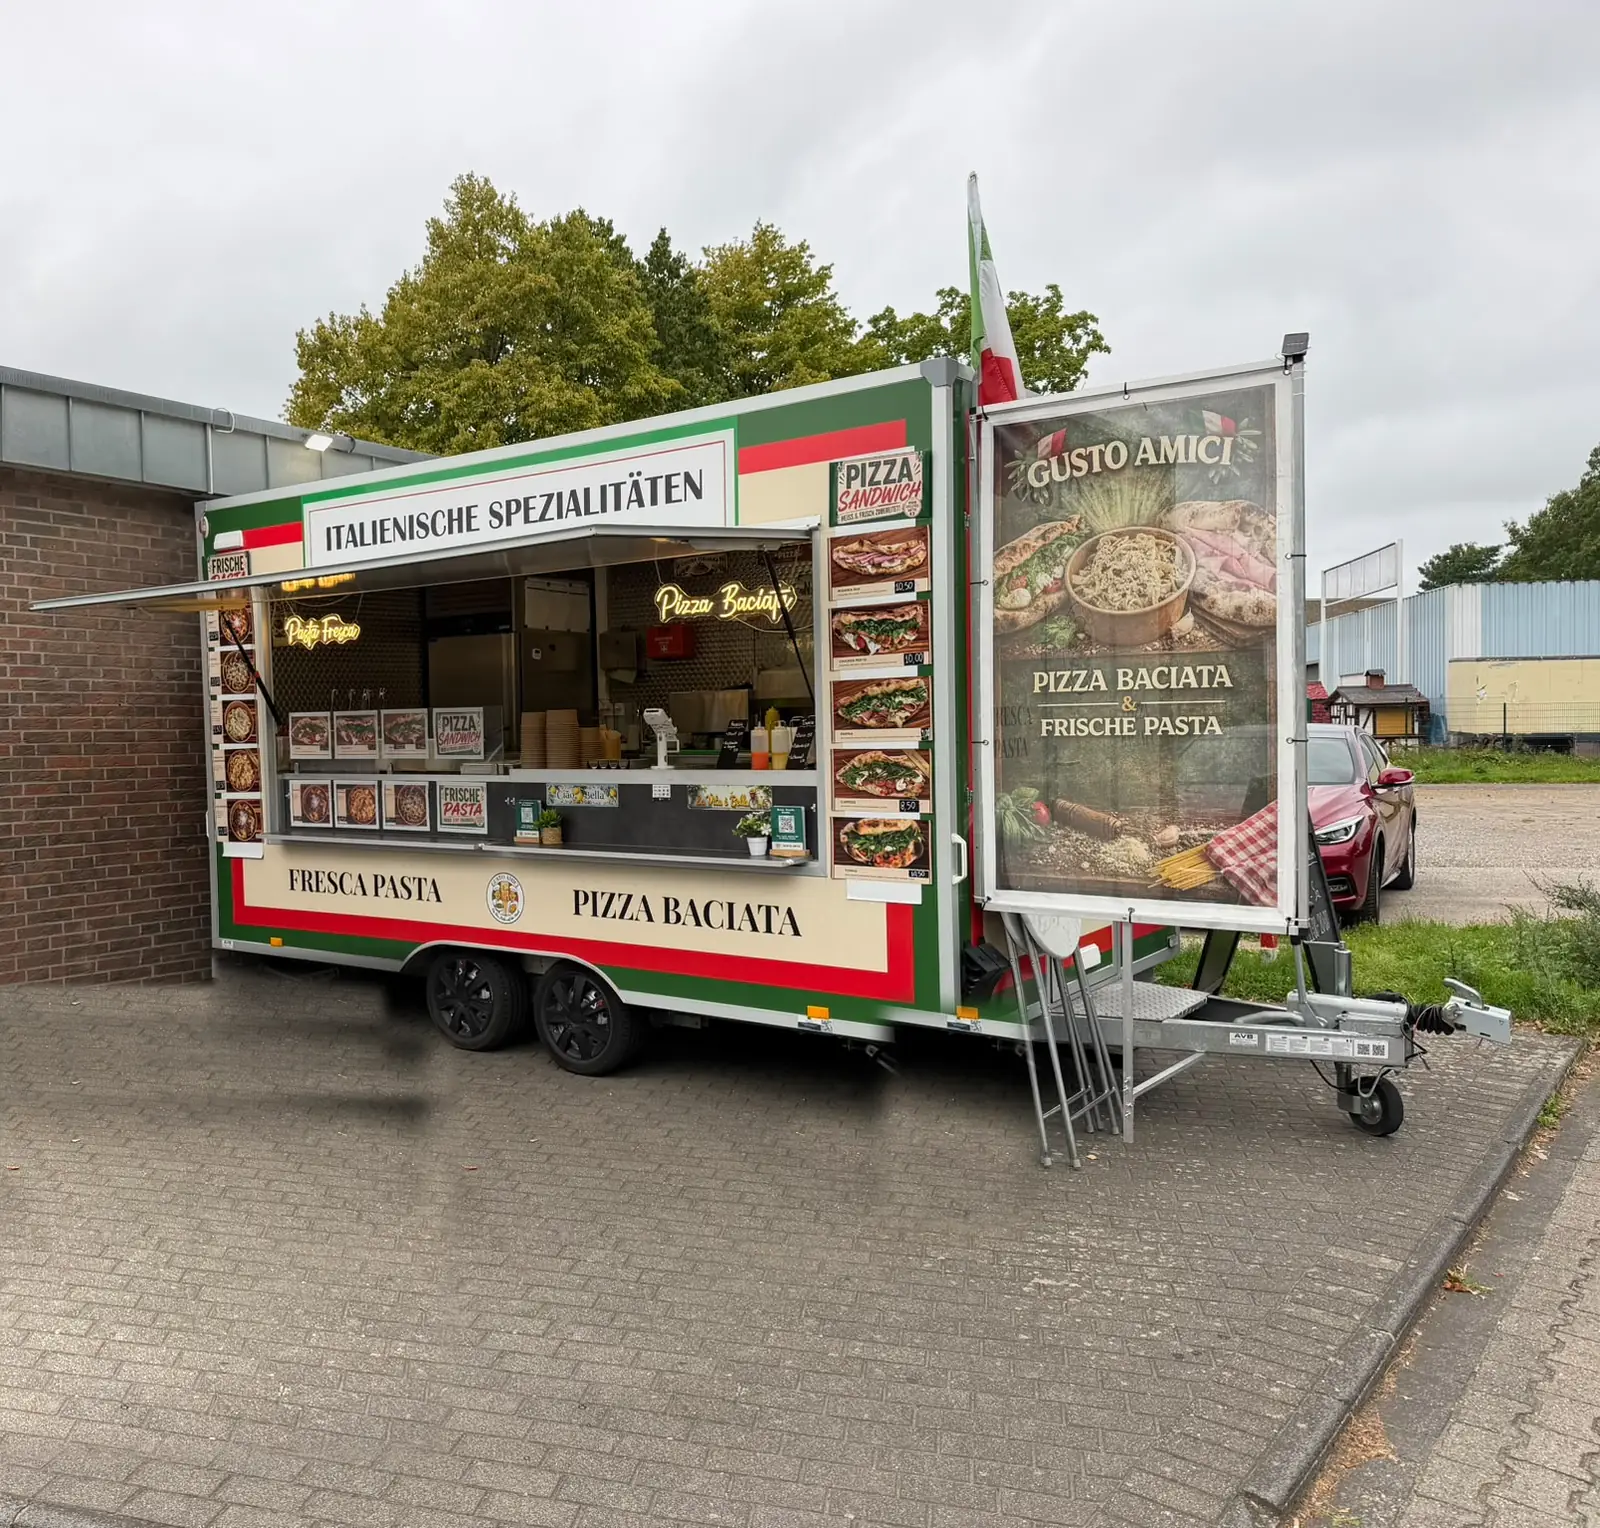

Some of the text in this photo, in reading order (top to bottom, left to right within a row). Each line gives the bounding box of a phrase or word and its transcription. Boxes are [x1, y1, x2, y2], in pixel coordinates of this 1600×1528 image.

[846, 457, 914, 489] PIZZA
[1027, 434, 1234, 488] GUSTO AMICI
[326, 469, 703, 551] ITALIENISCHE SPEZIALITÄTEN
[838, 481, 922, 512] SANDWICH
[211, 555, 244, 574] FRISCHE
[657, 585, 714, 621] Pizza
[284, 615, 359, 648] Pasta Fresca
[1033, 665, 1234, 694] PIZZA BACIATA
[1121, 695, 1137, 712] &
[438, 730, 481, 746] SANDWICH
[442, 715, 476, 732] PIZZA
[1040, 717, 1137, 737] FRISCHE
[1144, 715, 1223, 736] PASTA
[443, 802, 482, 816] PASTA
[444, 787, 480, 802] FRISCHE
[288, 868, 443, 903] FRESCA PASTA
[572, 889, 803, 938] PIZZA BACIATA
